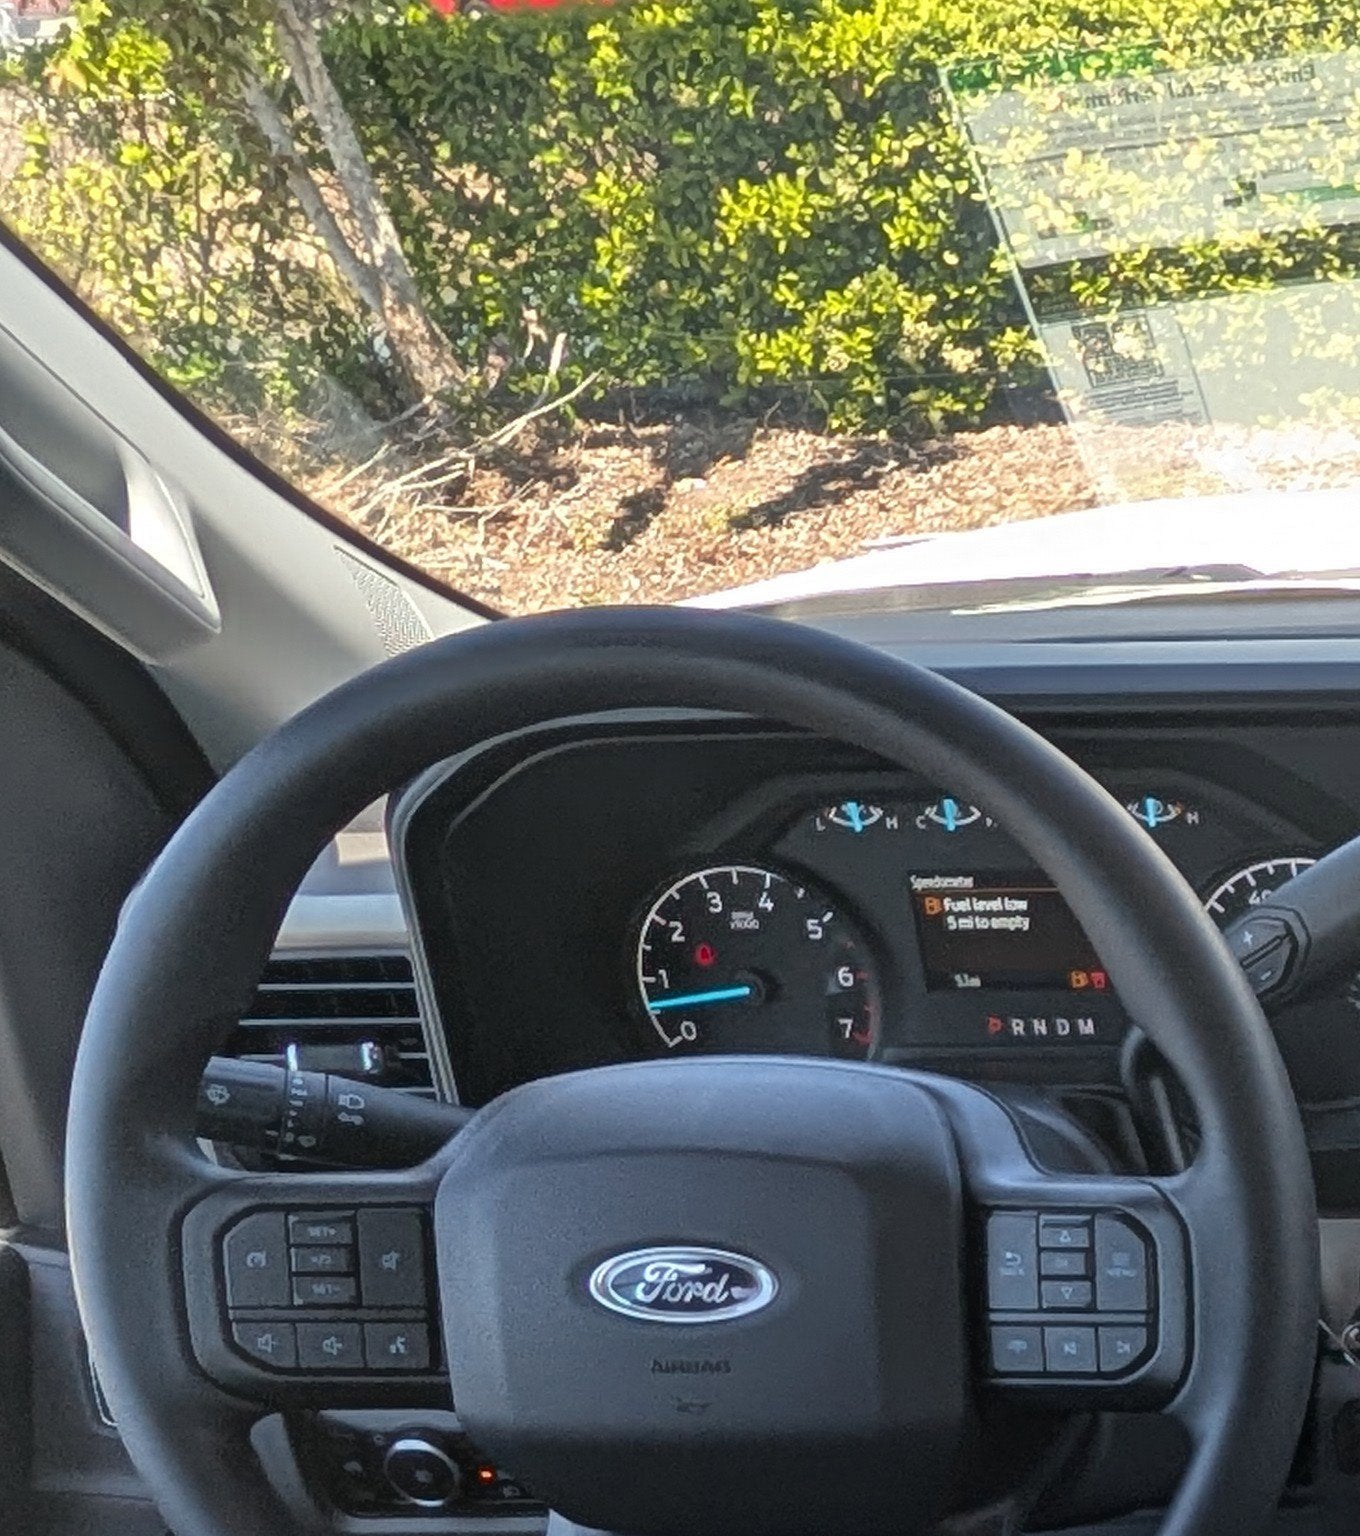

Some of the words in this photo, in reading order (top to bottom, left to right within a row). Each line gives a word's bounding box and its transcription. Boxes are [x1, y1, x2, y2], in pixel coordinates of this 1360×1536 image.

[706, 891, 723, 913] 3
[758, 891, 775, 913] 4
[943, 897, 970, 911] Fuel
[972, 897, 1003, 911] level
[669, 921, 686, 942] 2
[806, 919, 823, 940] 5
[657, 969, 670, 989] 1
[838, 966, 855, 987] 6
[680, 1021, 697, 1040] 0
[837, 1018, 854, 1039] 7
[1010, 1018, 1025, 1035] R
[1033, 1018, 1048, 1035] N
[1056, 1018, 1071, 1035] D
[1078, 1018, 1095, 1035] M
[634, 1261, 732, 1304] Ford
